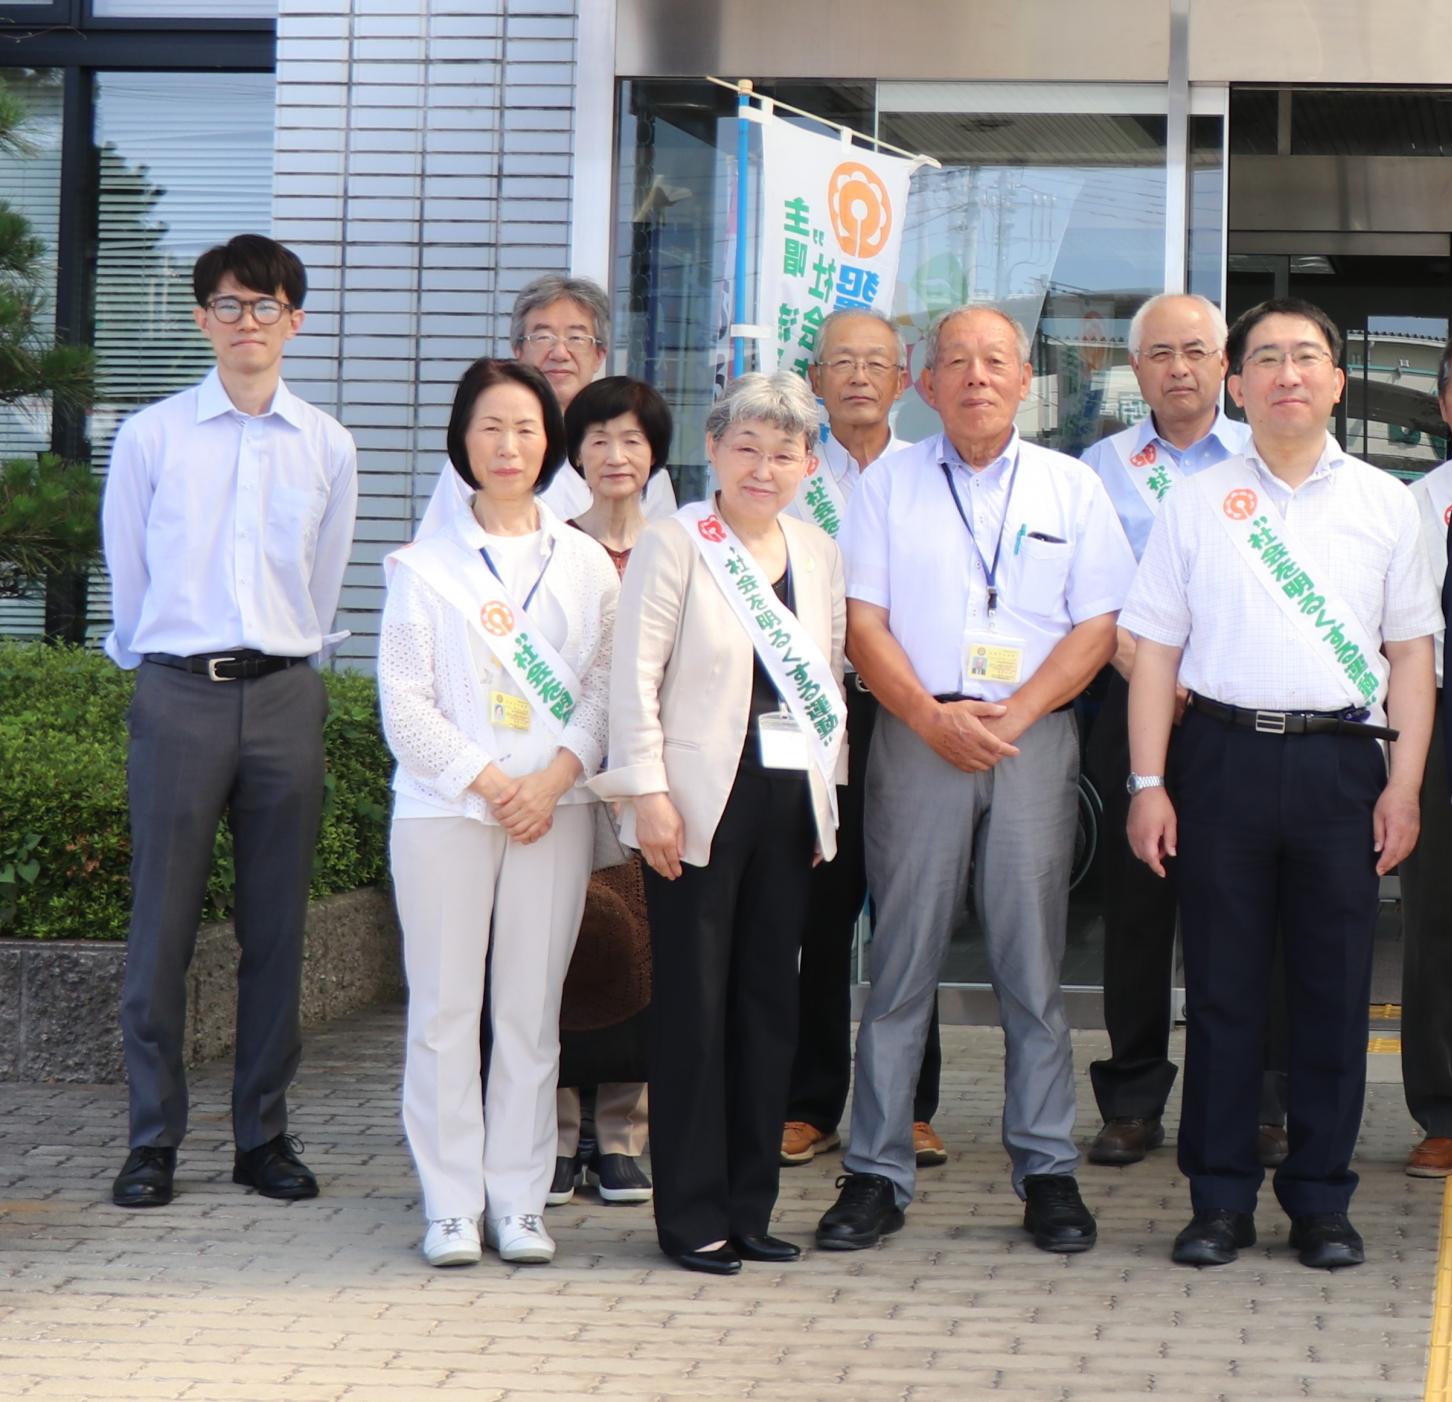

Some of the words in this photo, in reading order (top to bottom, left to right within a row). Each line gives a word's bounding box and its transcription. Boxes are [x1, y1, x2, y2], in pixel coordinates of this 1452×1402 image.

[805, 477, 841, 540] “社会を
[513, 632, 576, 729] “社会を明
